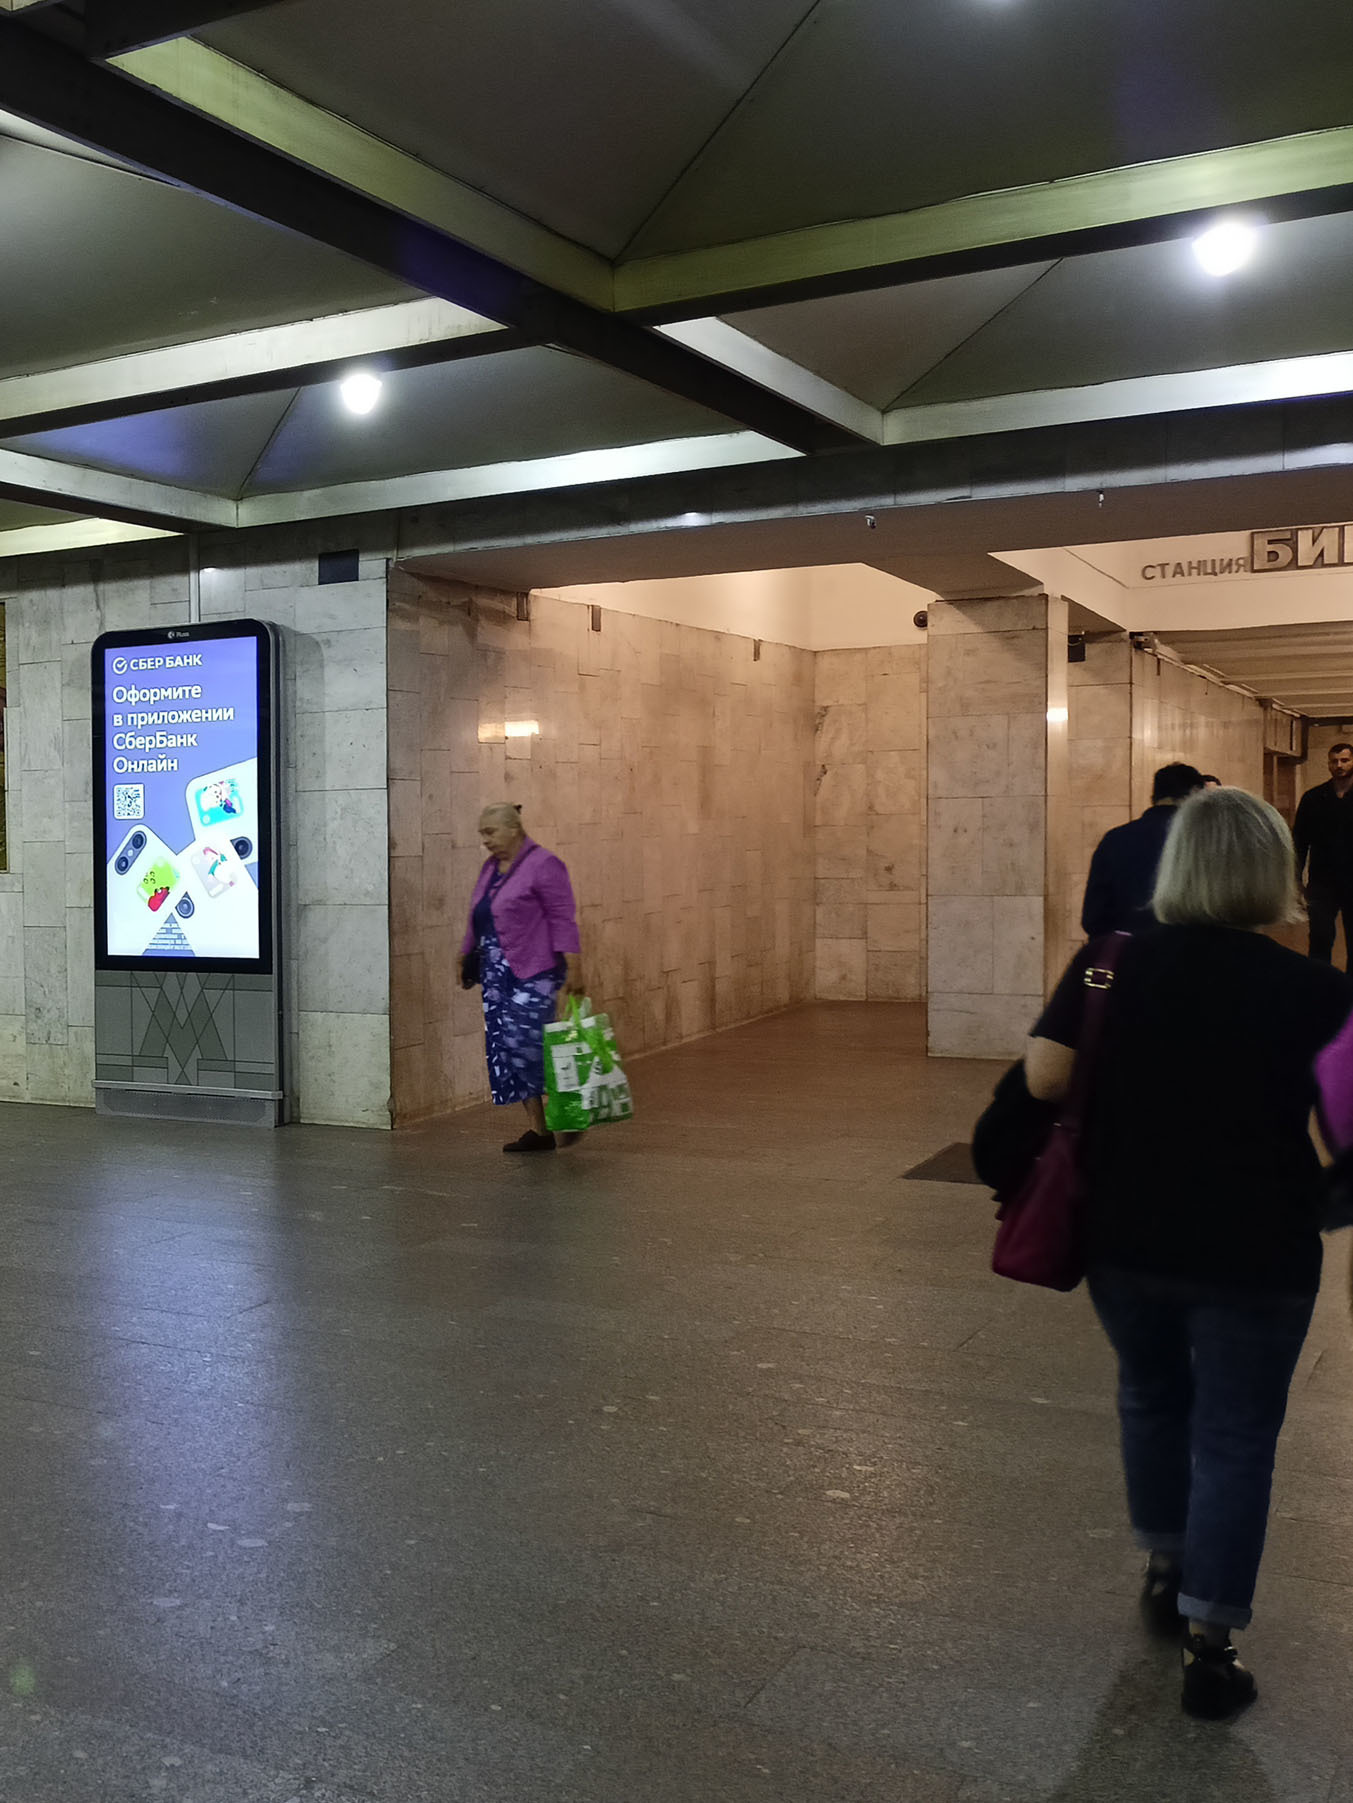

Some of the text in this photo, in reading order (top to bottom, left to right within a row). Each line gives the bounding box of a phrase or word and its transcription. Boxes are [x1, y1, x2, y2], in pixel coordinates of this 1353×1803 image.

[1141, 556, 1249, 580] СТАНЦИЯ
[130, 654, 203, 671] СБЕР БАНК
[112, 684, 202, 706] Оформите
[113, 707, 235, 729] в приложении
[113, 731, 198, 752] СберБанк
[113, 754, 179, 773] Онлайн
